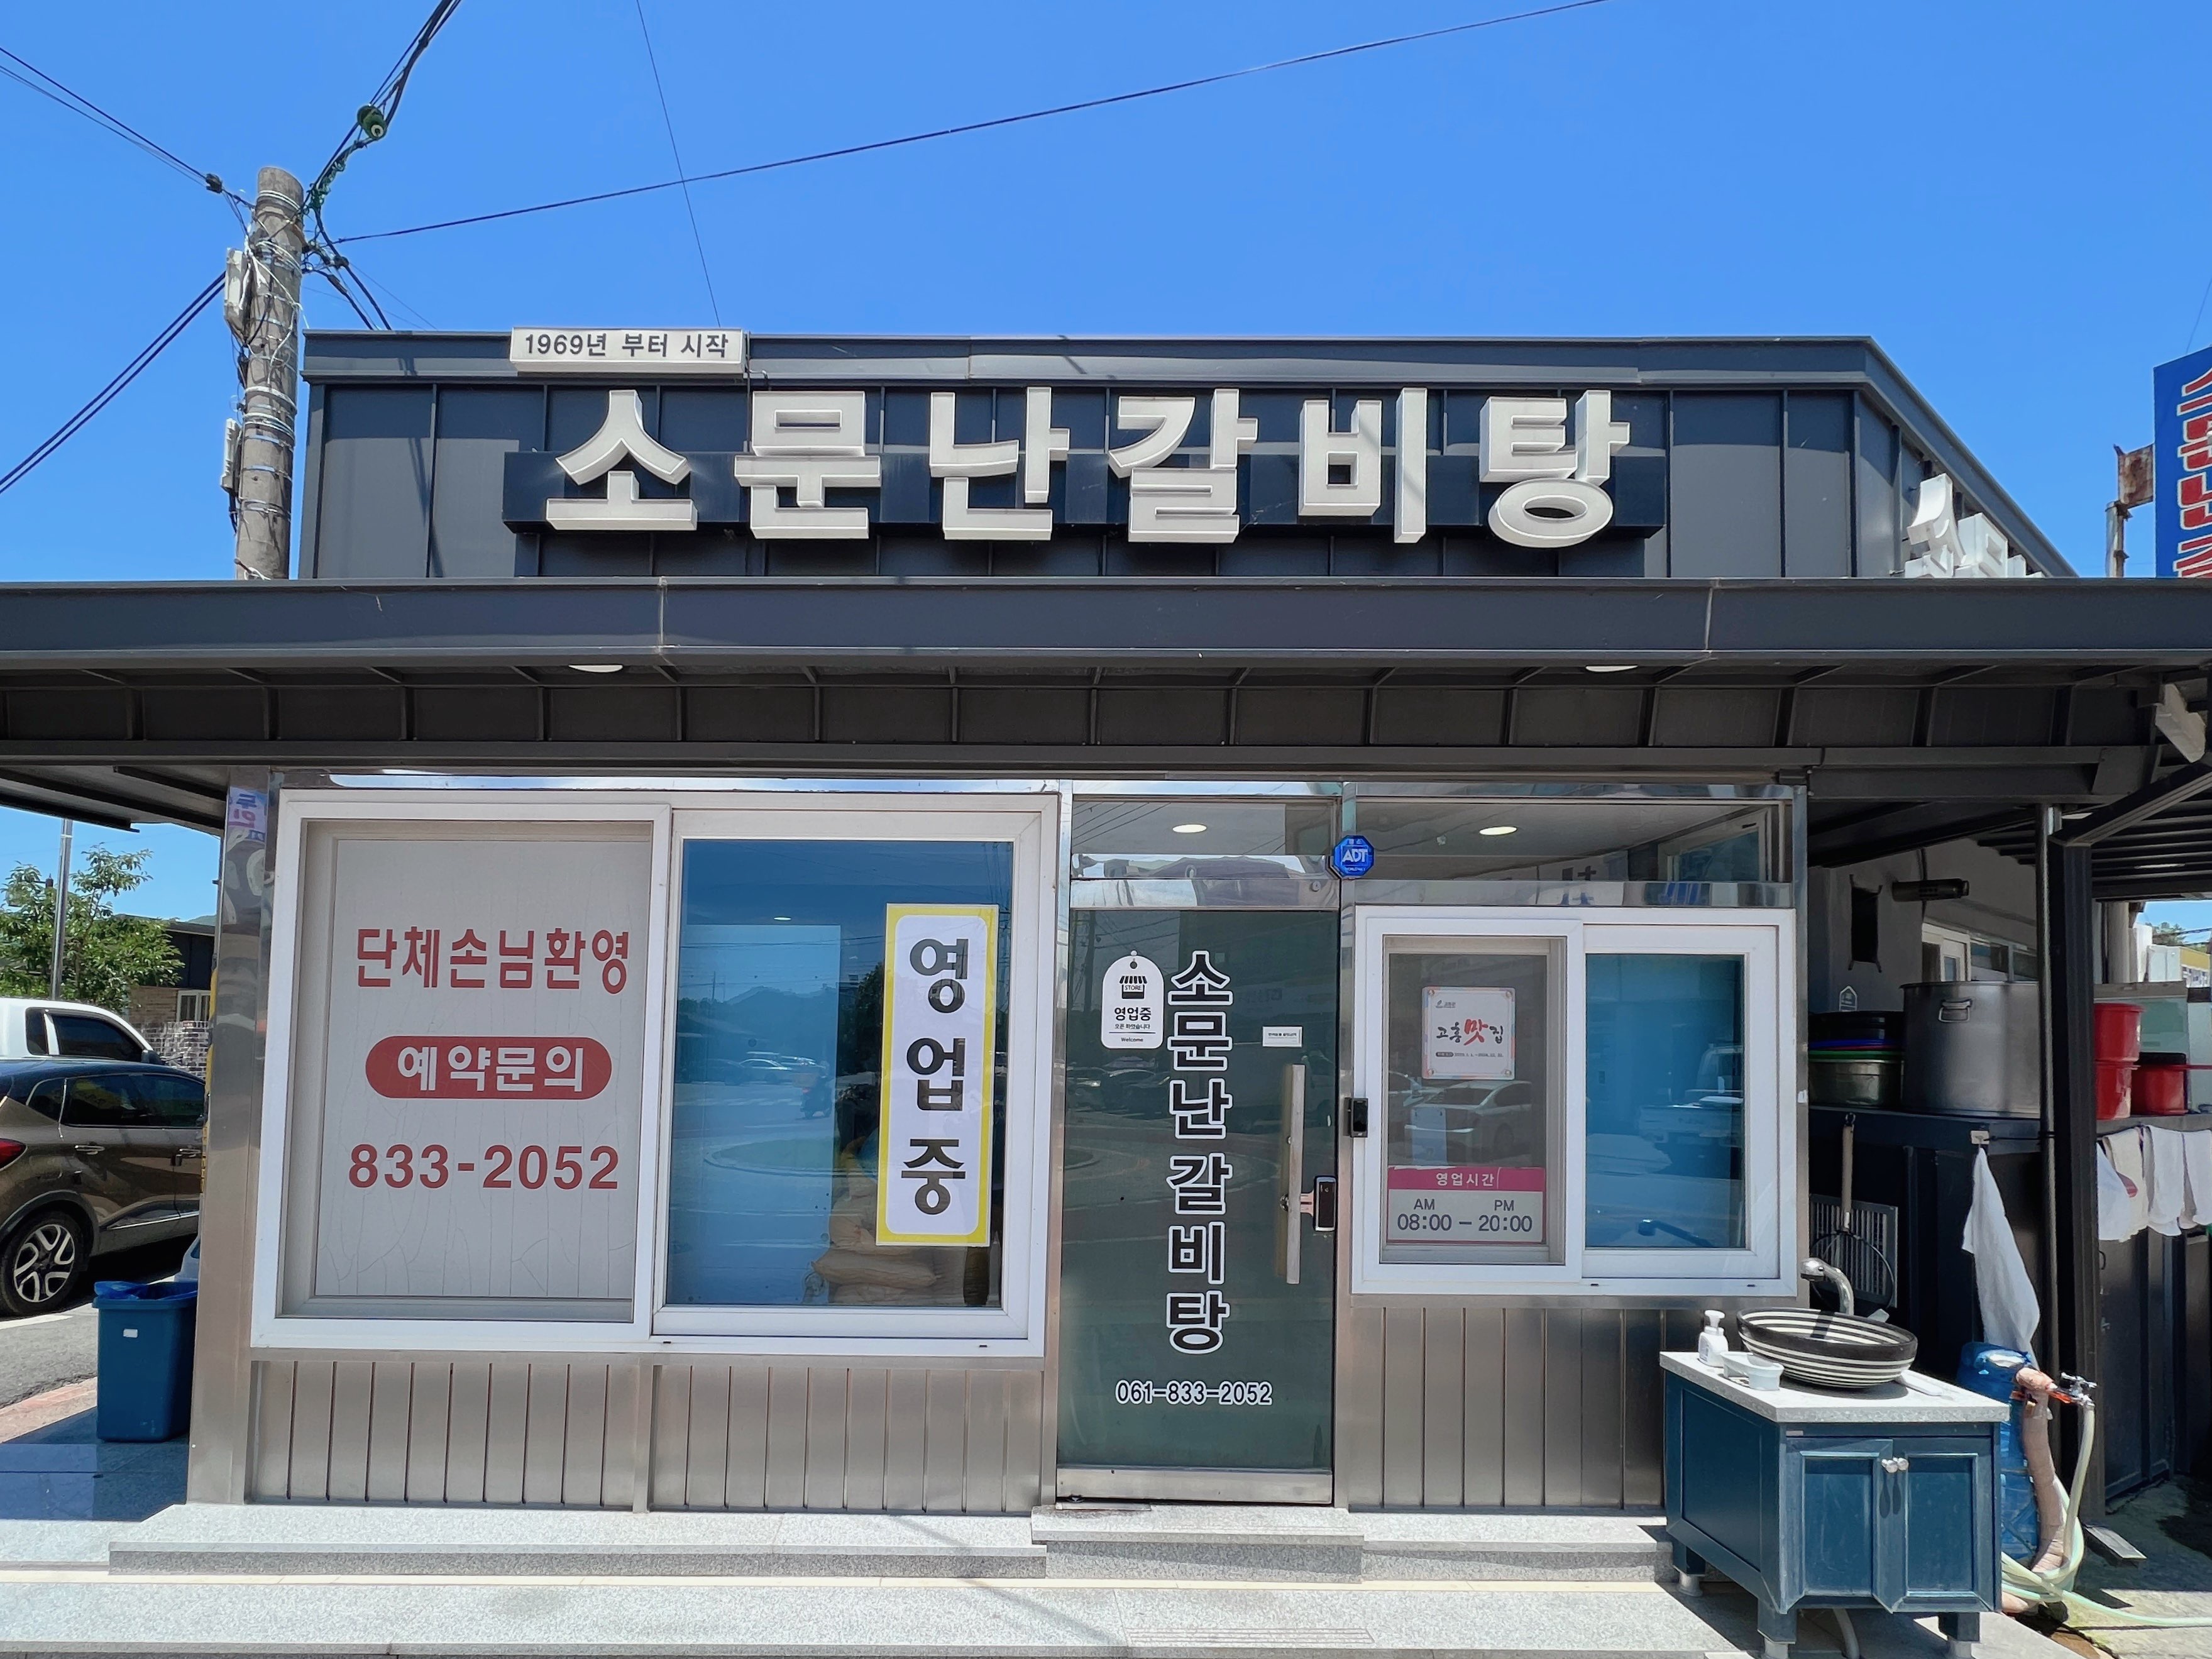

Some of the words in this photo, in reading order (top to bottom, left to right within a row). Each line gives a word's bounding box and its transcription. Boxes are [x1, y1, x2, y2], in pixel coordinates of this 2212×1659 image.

[525, 333, 607, 357] 1969년
[622, 333, 669, 358] 부터
[681, 333, 729, 359] 시작
[546, 387, 1631, 549] 소문난갈비탕
[1342, 849, 1368, 862] ADT
[357, 926, 630, 995] 단체손님환영
[1114, 1007, 1152, 1021] 영업중
[397, 1045, 584, 1093] 예약문의
[901, 938, 969, 1215] 영업중
[1166, 950, 1233, 1355] 소문난갈비탕
[348, 1143, 620, 1190] 833-2052
[1436, 1172, 1495, 1187] 영업시간
[1413, 1198, 1436, 1211] AM
[1494, 1199, 1515, 1211] PM
[1397, 1213, 1452, 1231] 08:00
[1478, 1215, 1532, 1232] 20:00
[1115, 1379, 1273, 1406] 061-833-2052
